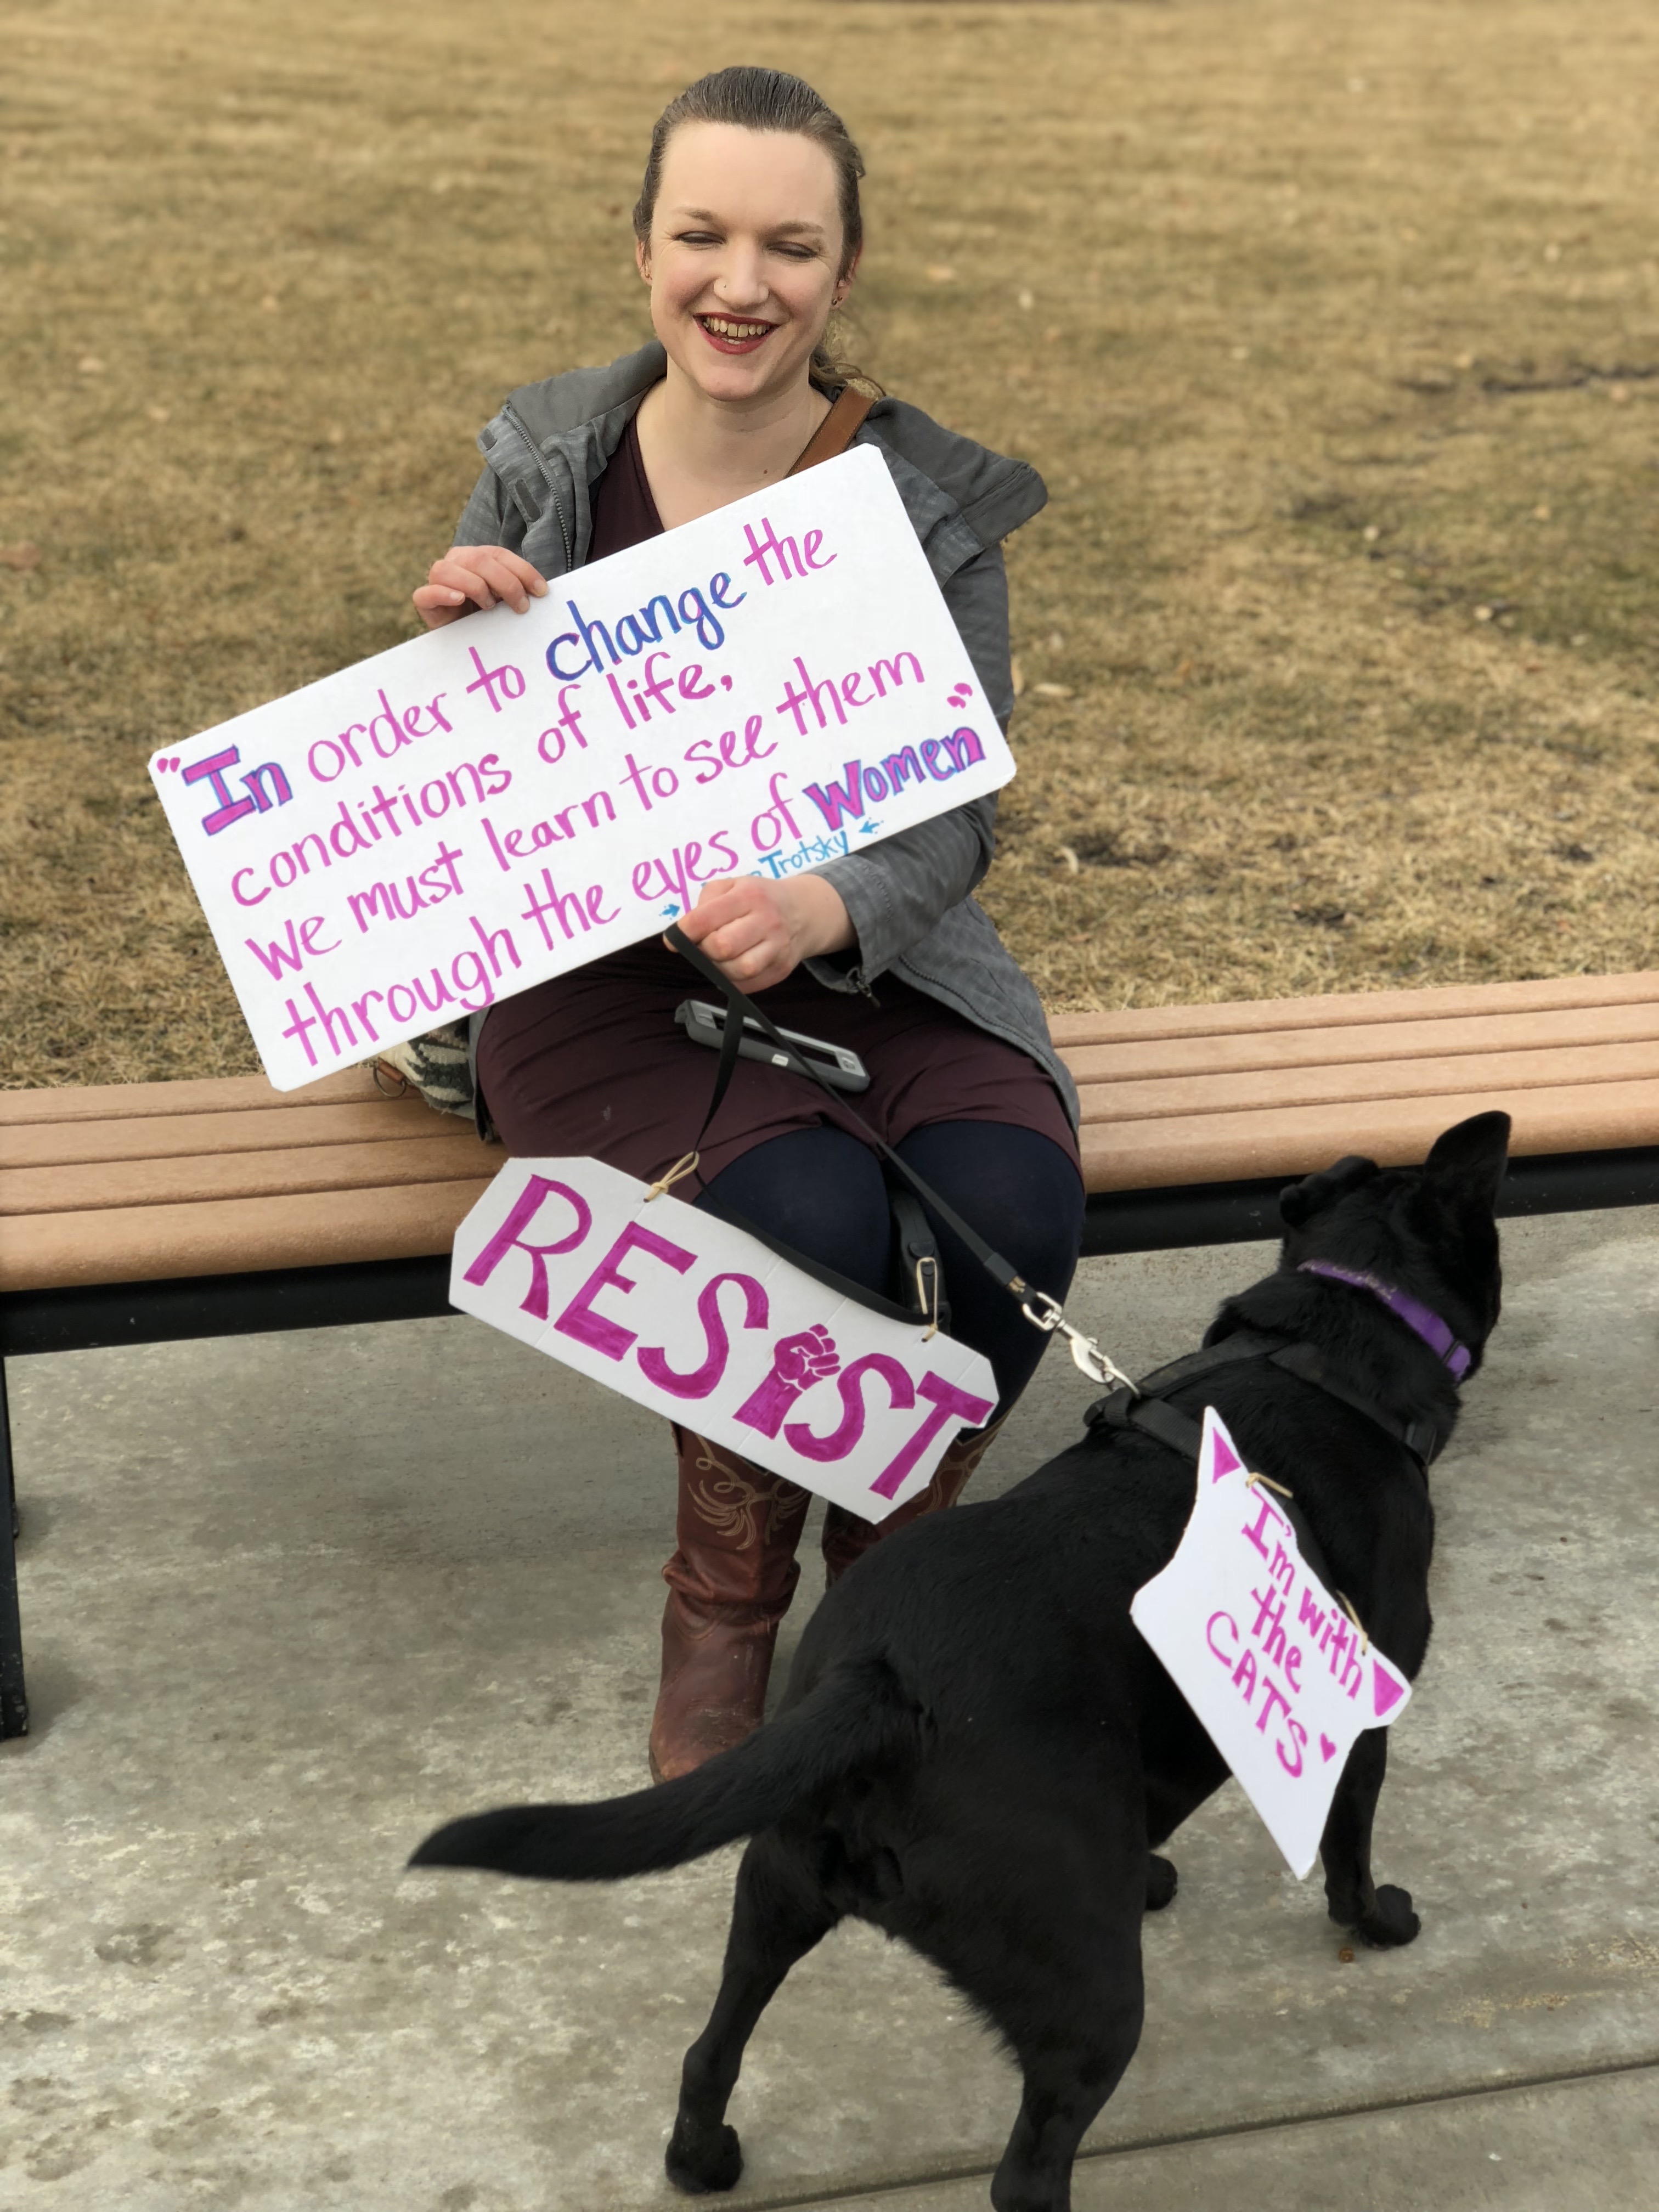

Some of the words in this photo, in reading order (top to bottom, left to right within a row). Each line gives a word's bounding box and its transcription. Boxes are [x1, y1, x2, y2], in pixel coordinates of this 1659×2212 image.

[308, 689, 453, 782] order
[466, 647, 526, 713] to
[546, 572, 747, 681] change
[743, 518, 837, 586] the
[232, 754, 512, 906] conditions
[538, 684, 588, 764] of
[347, 841, 464, 933] must
[481, 791, 616, 872] learn
[619, 753, 679, 811] to
[684, 715, 778, 783] see
[776, 652, 925, 736] them
[758, 830, 849, 879] Trotsky
[282, 916, 521, 1066] through
[521, 868, 621, 951] the
[632, 831, 738, 915] eyes
[751, 772, 803, 851] of
[462, 1174, 994, 1500] RESIST
[1206, 1611, 1308, 1779] CATS
[1241, 1486, 1295, 1596] I'm
[1298, 1587, 1363, 1700] with
[1251, 1583, 1302, 1694] the
